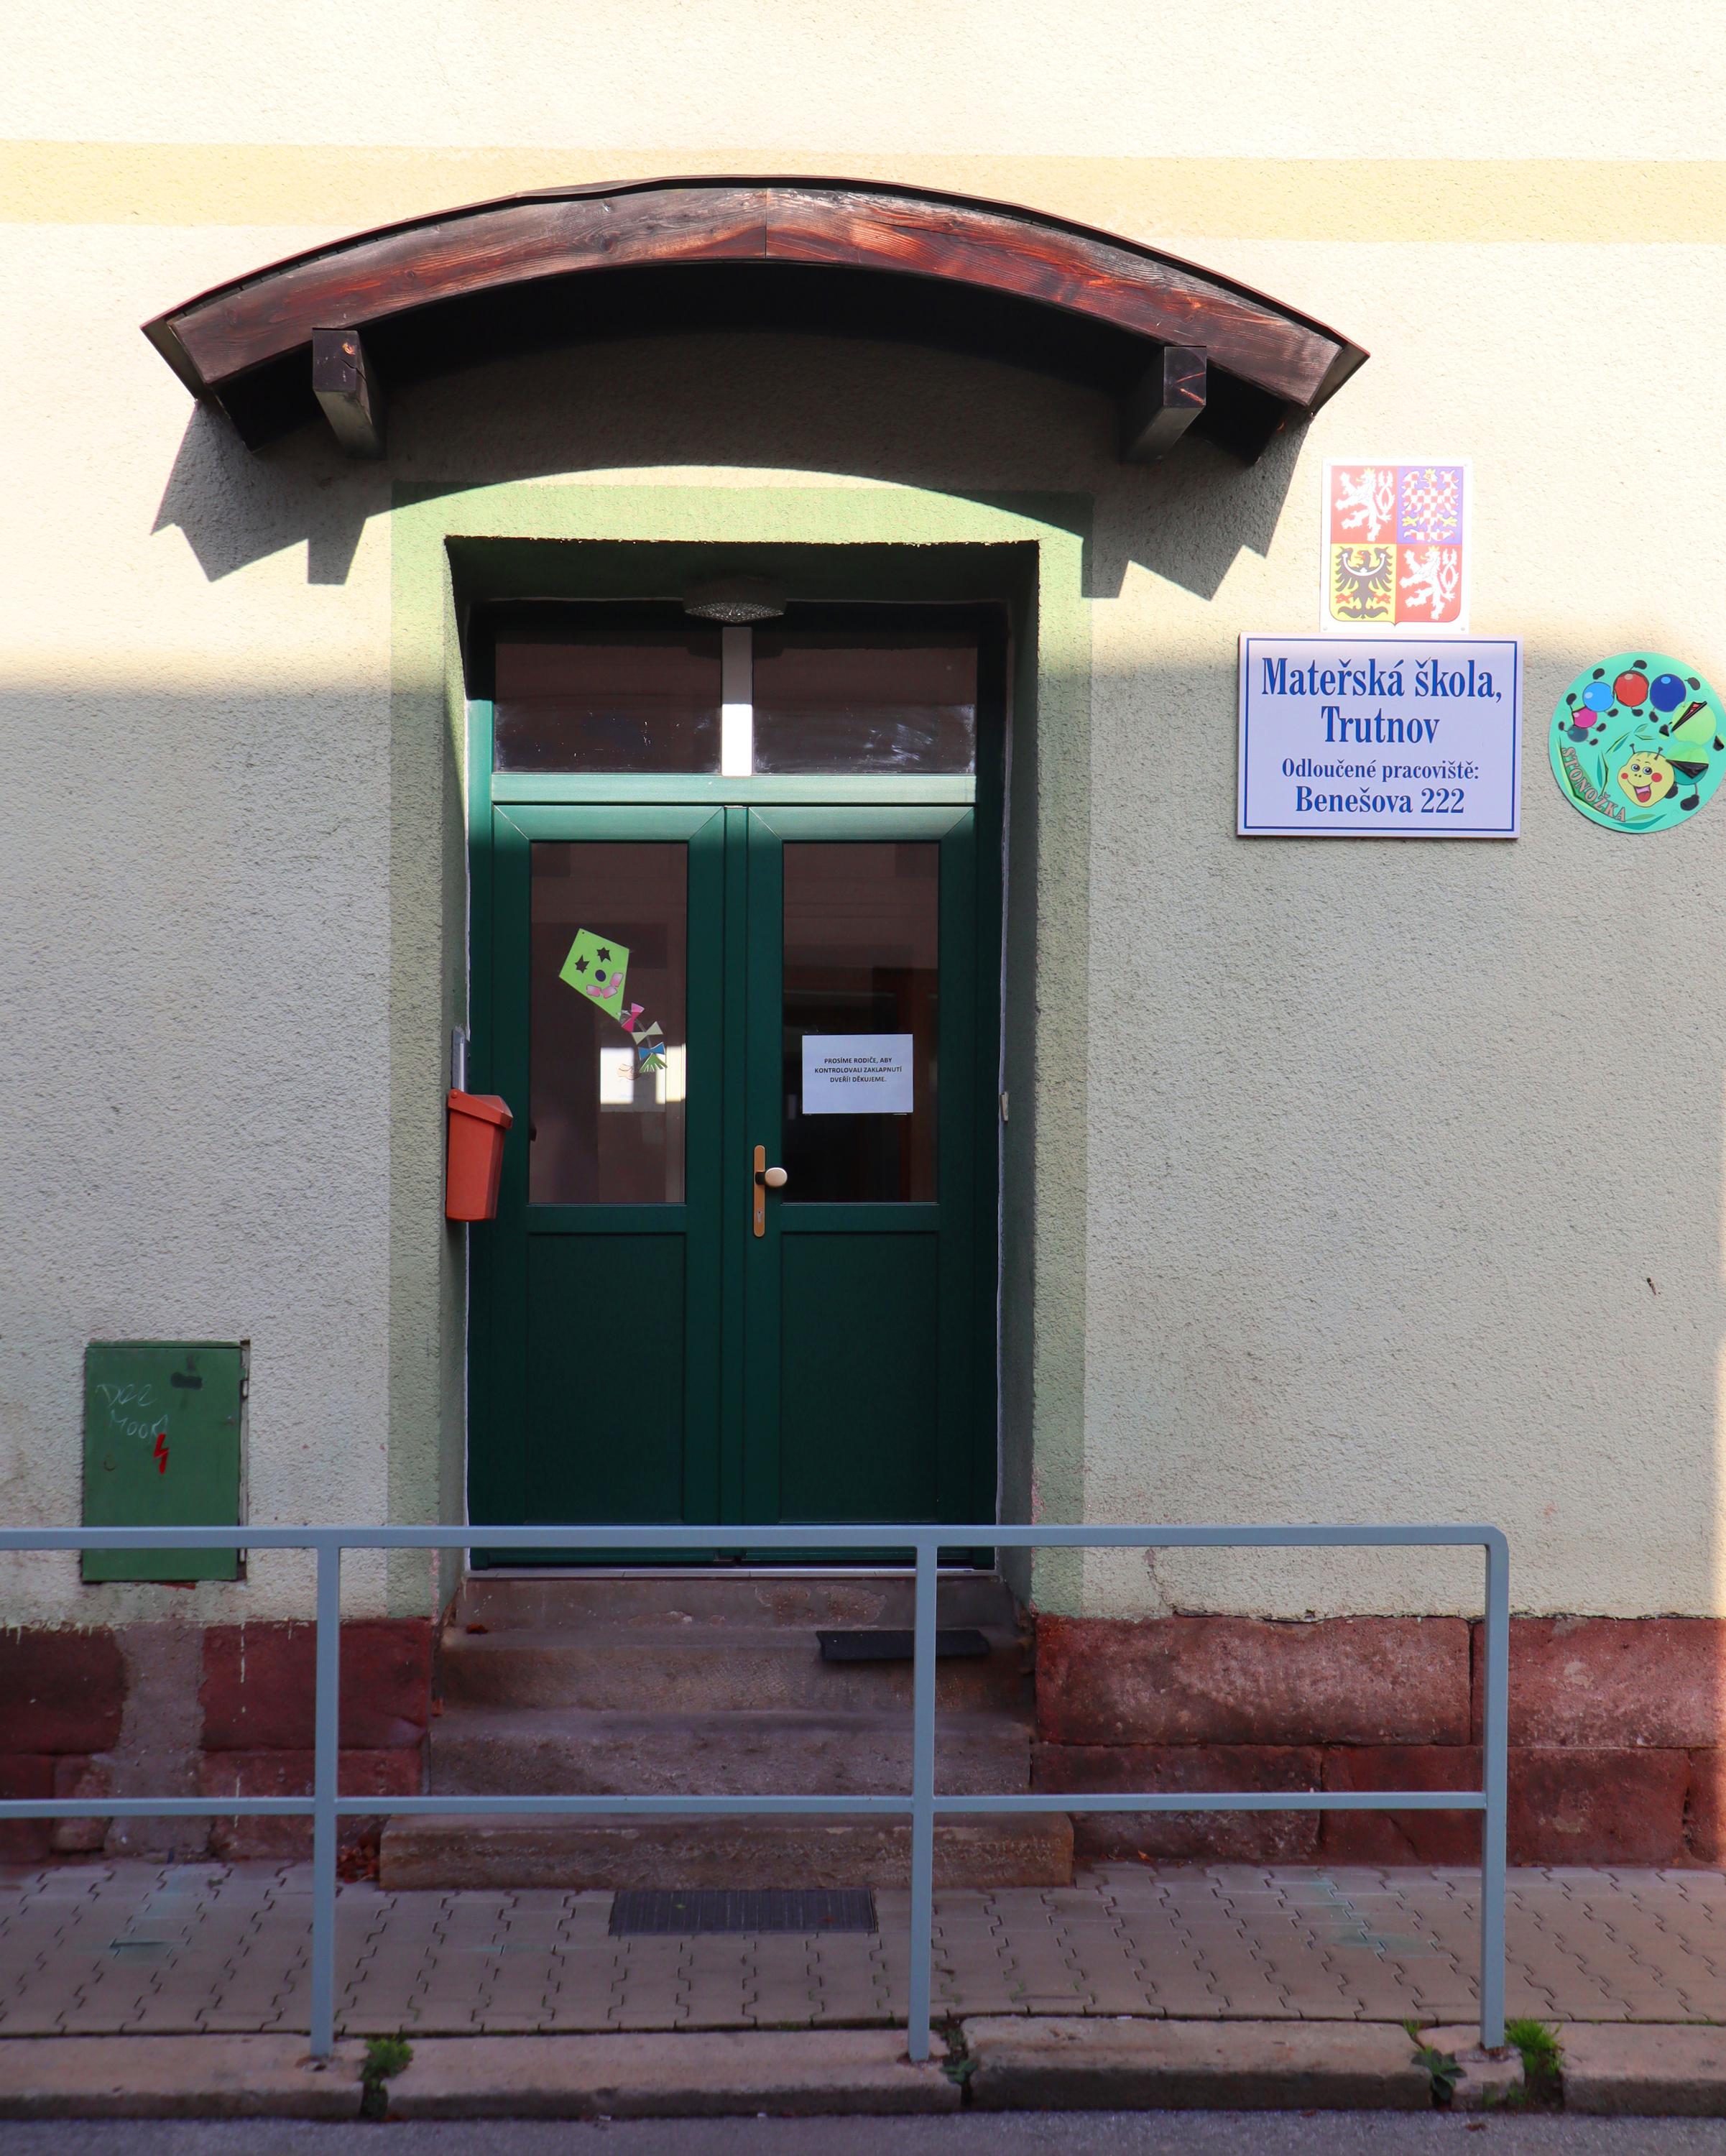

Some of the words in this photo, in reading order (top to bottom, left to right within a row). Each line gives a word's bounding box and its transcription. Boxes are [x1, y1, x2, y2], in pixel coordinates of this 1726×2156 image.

[1261, 657, 1405, 697] Mateřská
[1414, 657, 1503, 704] škola,
[1320, 705, 1441, 745] Trutnov
[1281, 757, 1377, 779] Odloučené
[1381, 759, 1480, 783] pracoviště:
[1561, 746, 1626, 823] STONOŽKA
[1295, 785, 1413, 814] Benešova
[1420, 787, 1466, 814] 222
